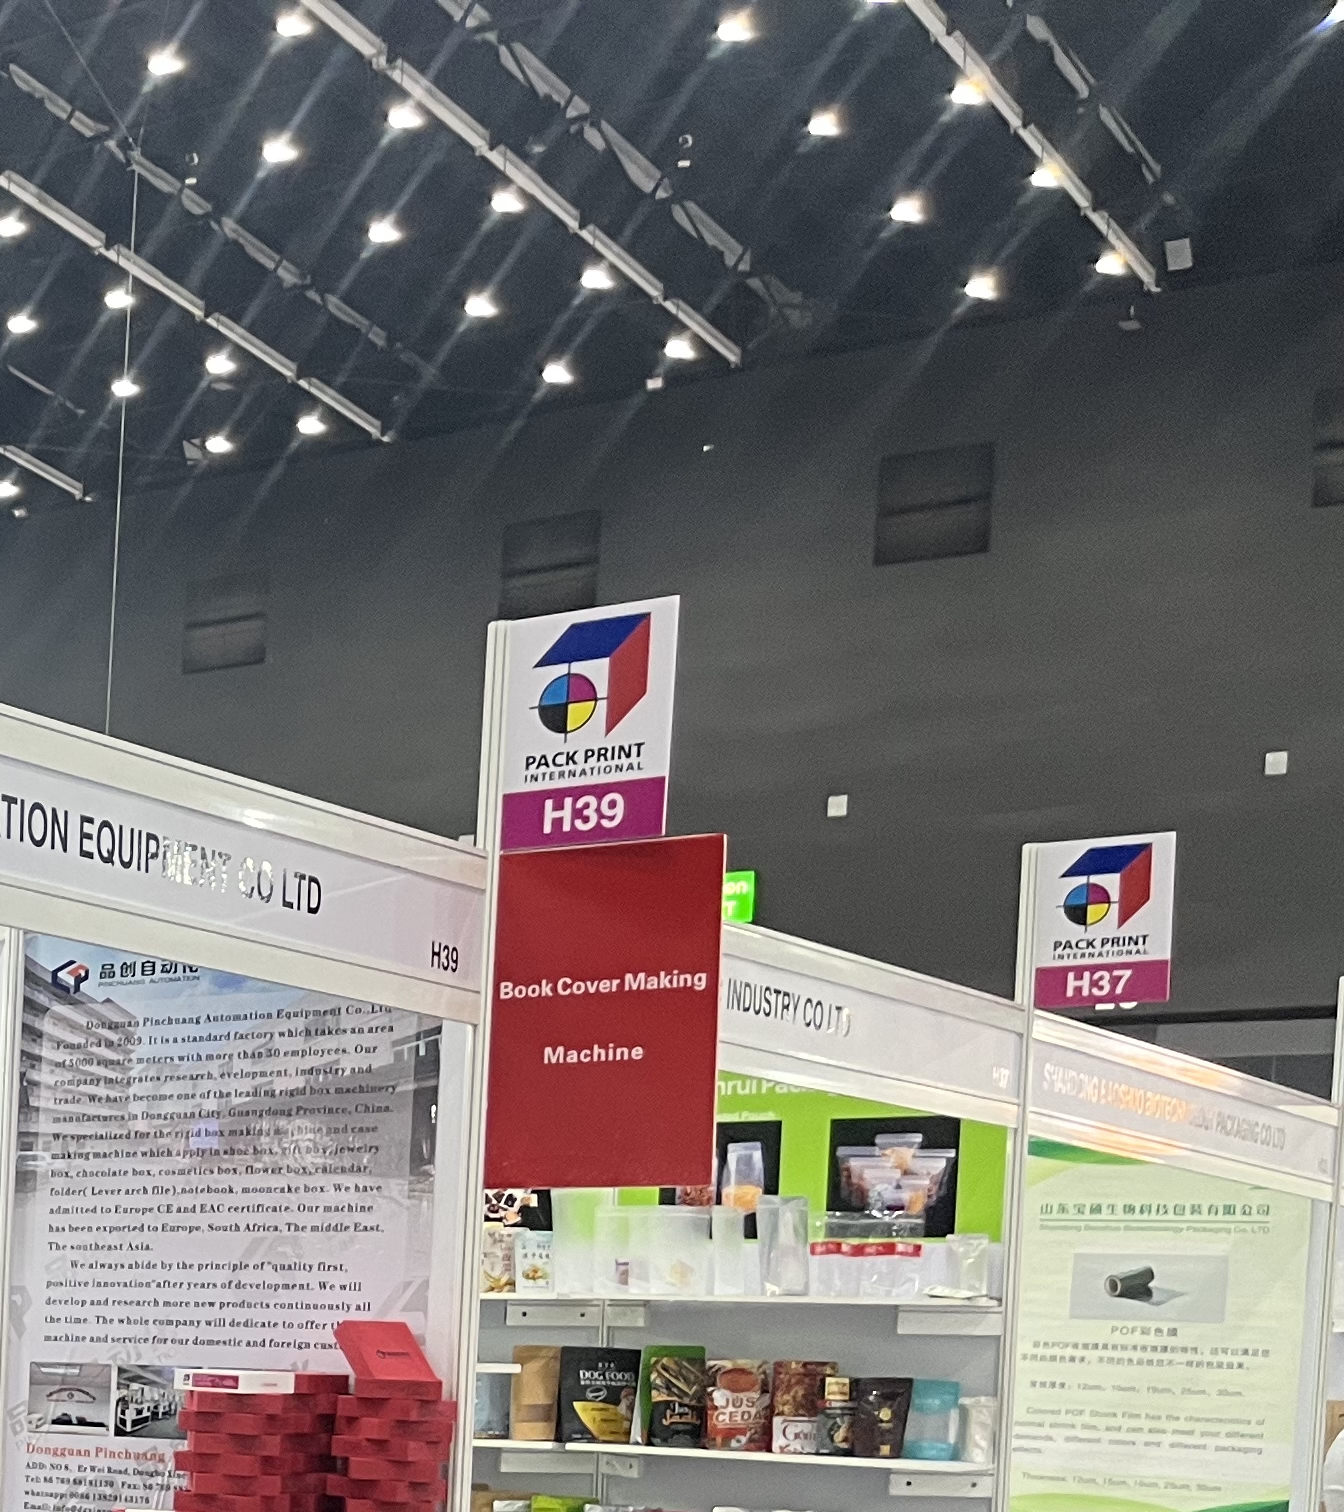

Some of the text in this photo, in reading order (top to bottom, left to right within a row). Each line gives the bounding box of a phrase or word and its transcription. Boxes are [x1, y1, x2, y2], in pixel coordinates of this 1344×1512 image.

[525, 742, 645, 771] PACK PRINT
[524, 761, 644, 784] INTERNATIONAL
[542, 792, 624, 835] H39
[79, 814, 231, 894] EQUIPMENT
[237, 857, 274, 904] CO
[281, 868, 322, 915] LTD
[1053, 934, 1149, 951] PACK PRINT
[1053, 948, 1149, 960] INTERNATIONAL
[431, 940, 459, 973] H39
[499, 970, 707, 1000] Book Cover Making
[1066, 969, 1132, 998] H37
[726, 977, 801, 1026] INDUSTRY
[803, 997, 824, 1031] CO
[86, 1019, 140, 1031] Dongguan
[143, 1015, 201, 1027] Pinchuang
[204, 1010, 273, 1023] Automation
[276, 1007, 342, 1020] Equipment
[543, 1043, 644, 1065] Machine
[49, 1205, 97, 1214] admitted
[100, 1206, 111, 1214] to
[114, 1205, 154, 1216] Europe
[157, 1203, 173, 1213] CE
[175, 1204, 196, 1213] and
[199, 1203, 225, 1213] EAC
[297, 1203, 320, 1213] Our
[323, 1203, 374, 1213] machine
[48, 1223, 65, 1233] has
[68, 1224, 93, 1233] been
[96, 1223, 144, 1234] exported
[161, 1223, 204, 1234] Europe,
[207, 1222, 240, 1233] South
[243, 1222, 282, 1233] Africa,
[285, 1222, 307, 1232] The
[310, 1222, 350, 1232] middle
[70, 1260, 85, 1269] We
[88, 1260, 125, 1271] always
[127, 1260, 157, 1270] abide
[160, 1261, 173, 1272] by
[176, 1261, 194, 1270] the
[197, 1261, 250, 1272] principle
[253, 1261, 266, 1271] of
[579, 1369, 635, 1380] DOG FOOD
[25, 1442, 165, 1463] Dongguan Pinchuang
